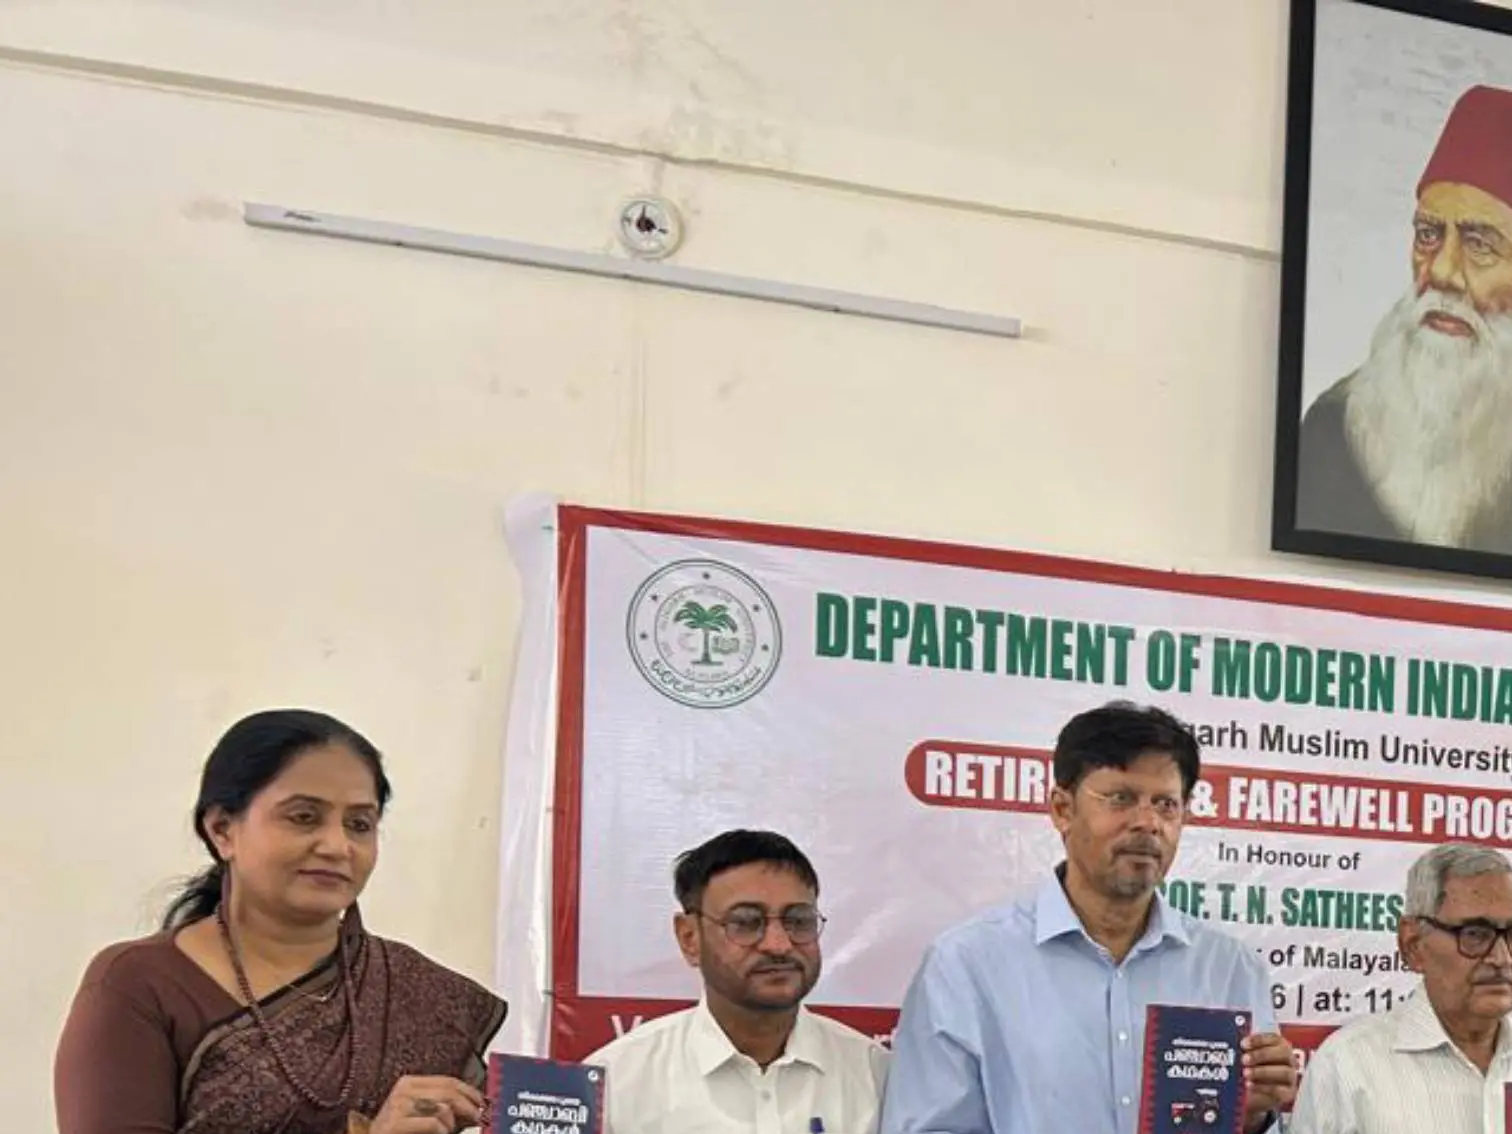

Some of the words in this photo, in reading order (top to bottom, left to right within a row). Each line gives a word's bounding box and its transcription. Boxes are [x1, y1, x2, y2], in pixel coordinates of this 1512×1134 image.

[815, 592, 1136, 686] DEPARTMENT
[1147, 630, 1202, 692] OF
[1212, 637, 1397, 714] MODERN
[1260, 723, 1369, 760] Muslim
[925, 750, 1053, 804] RETIR
[1190, 780, 1219, 819] &
[1227, 776, 1414, 833] FAREWELL
[1218, 842, 1239, 863] In
[1247, 844, 1331, 869] Honour
[1338, 852, 1361, 871] of
[1162, 880, 1210, 920] OF.
[1217, 883, 1238, 922] T.
[1247, 886, 1273, 924] N.
[1281, 887, 1404, 933] SATHEES
[1270, 944, 1296, 967] of
[1270, 983, 1287, 1010] 6
[1314, 987, 1351, 1013] at:
